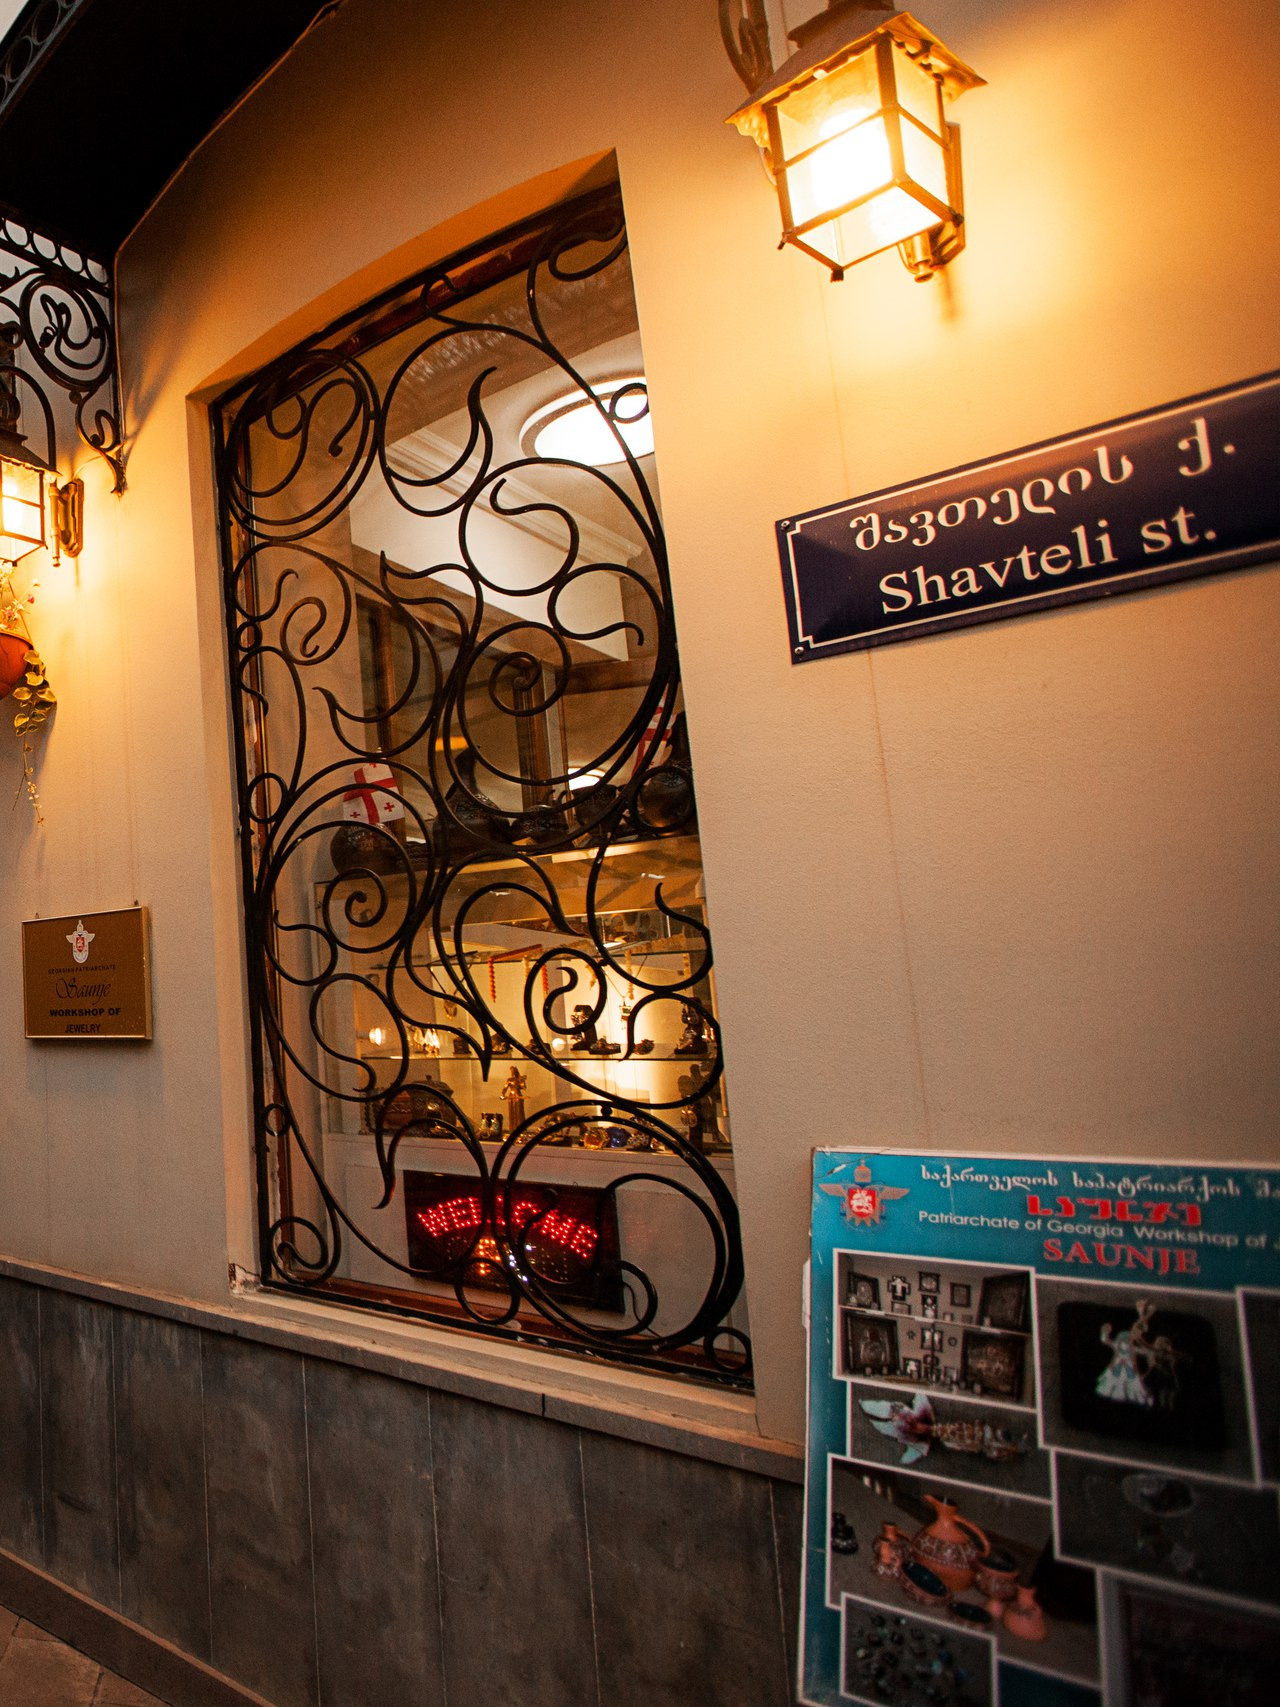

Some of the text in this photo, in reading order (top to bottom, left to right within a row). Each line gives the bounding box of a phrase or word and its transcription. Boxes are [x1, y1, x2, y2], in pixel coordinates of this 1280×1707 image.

[848, 416, 1236, 552] შავთელის ქ.
[878, 504, 1218, 615] Shavteli st.
[55, 977, 112, 1005] Saunje
[49, 1007, 122, 1017] WORKSHOP OF
[65, 1023, 101, 1034] JEWELRY
[920, 1164, 1060, 1192] საქართველოს
[1071, 1170, 1241, 1202] საპატრიარქოს
[919, 1210, 1020, 1229] Patriarchate
[1024, 1218, 1043, 1231] of
[1047, 1219, 1123, 1239] Georgia
[1132, 1225, 1239, 1248] Workshop
[1244, 1233, 1268, 1249] of
[1043, 1237, 1202, 1277] SAUNJE
